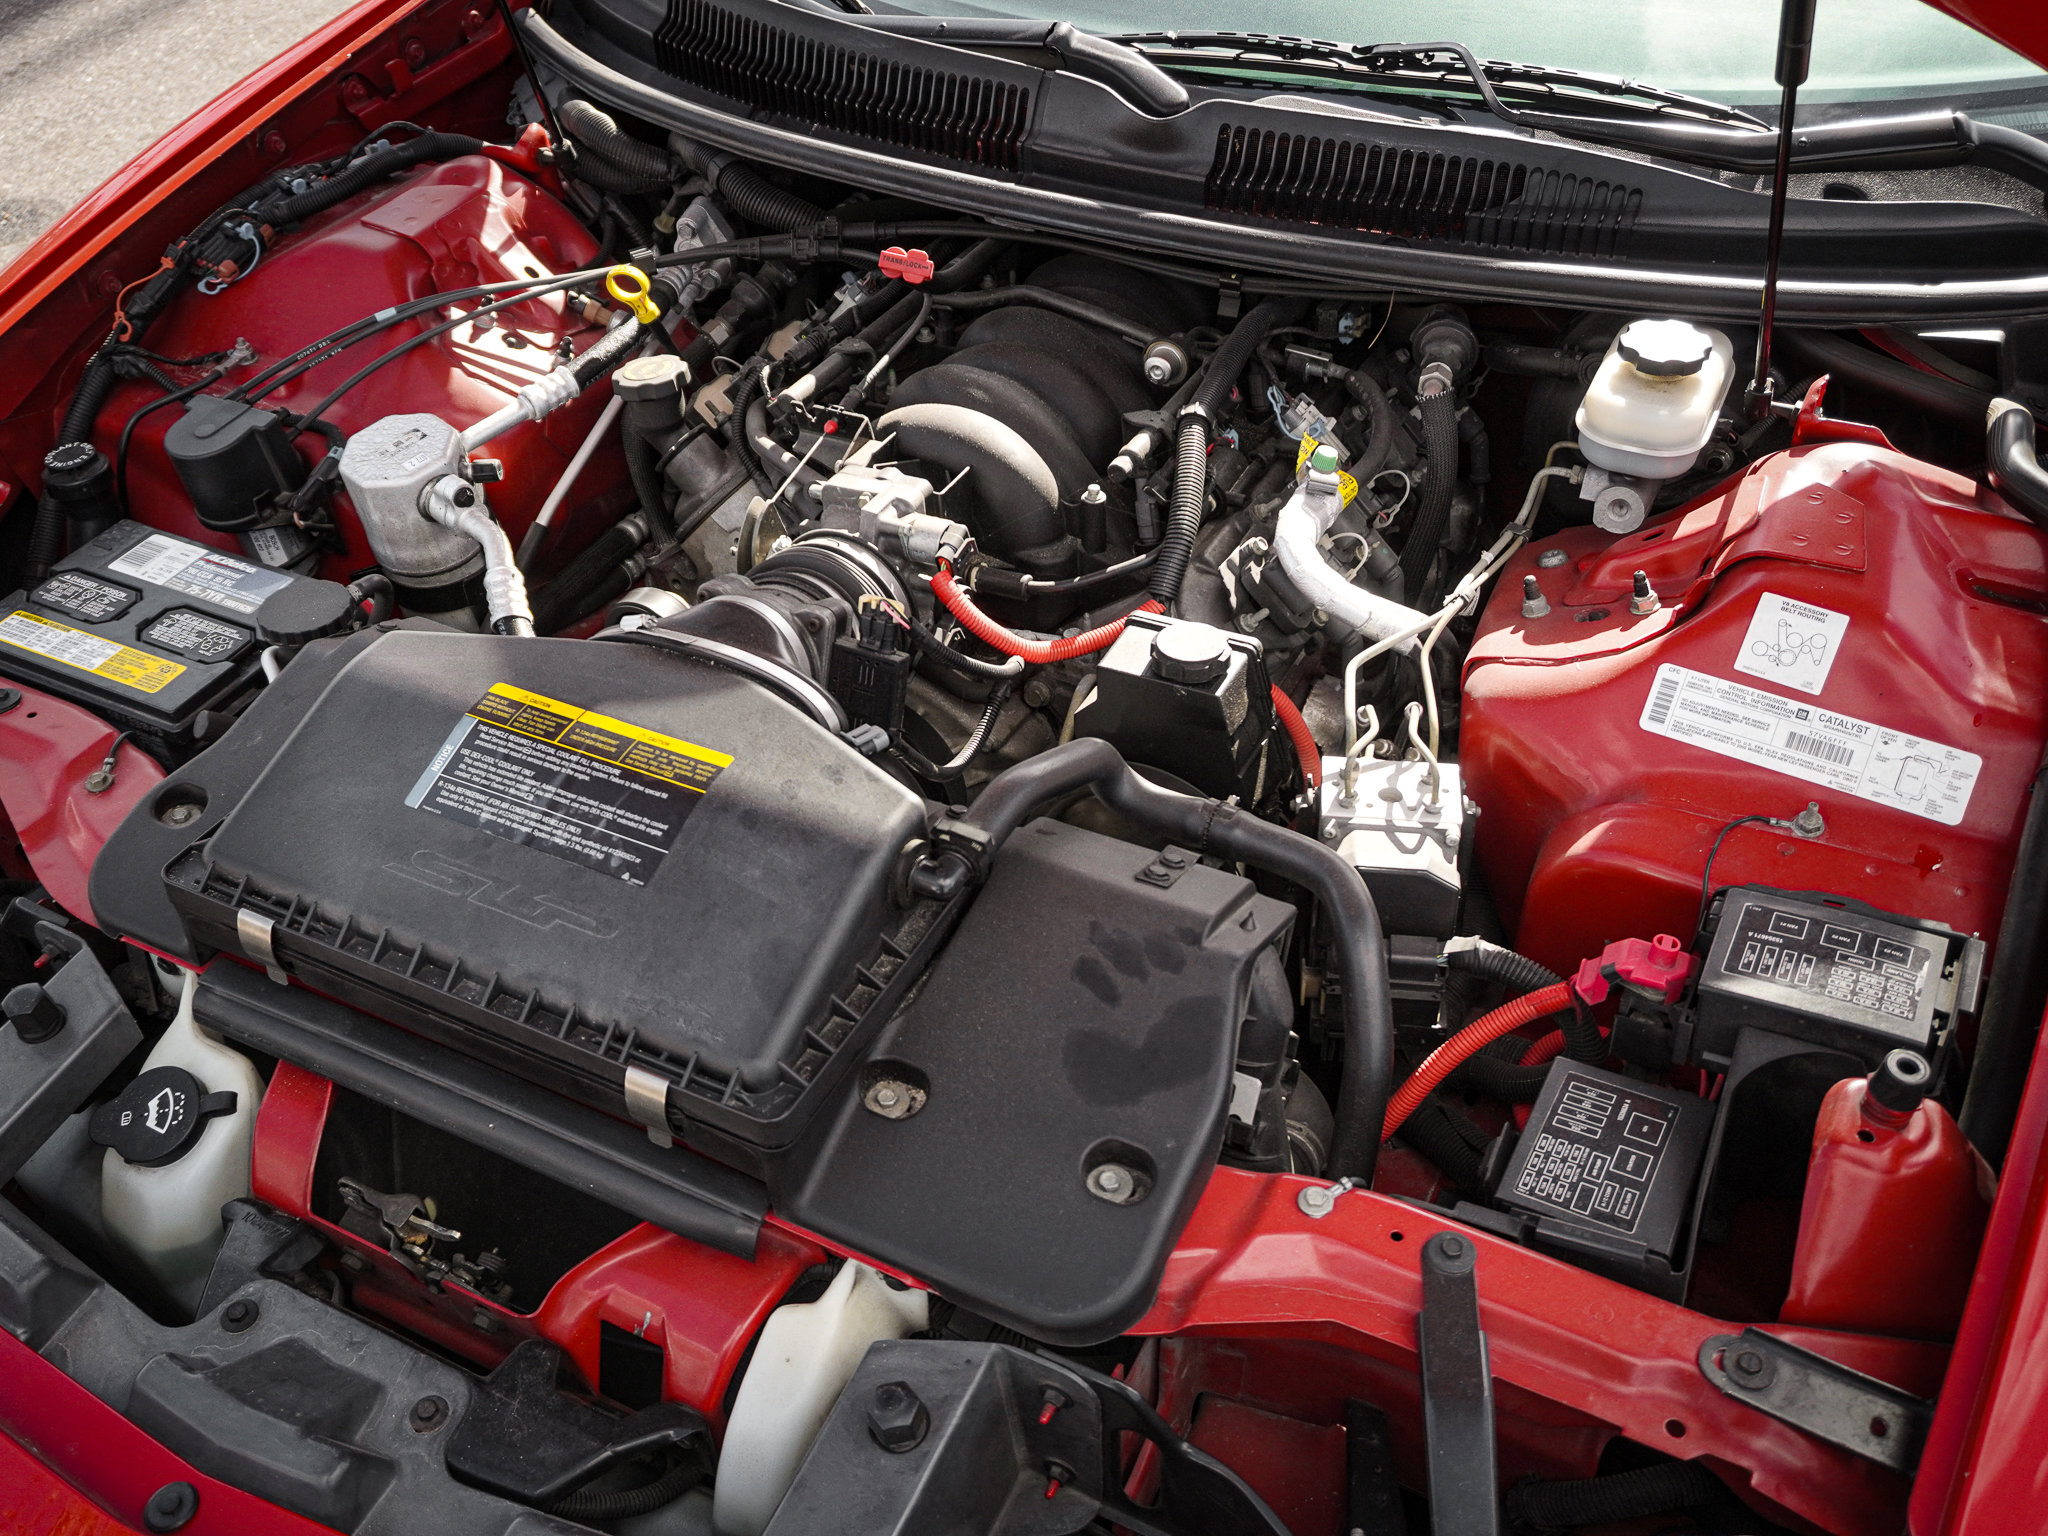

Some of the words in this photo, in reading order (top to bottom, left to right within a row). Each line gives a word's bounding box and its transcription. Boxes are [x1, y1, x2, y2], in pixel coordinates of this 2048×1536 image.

[192, 559, 244, 580] Professional
[203, 551, 260, 574] ACDelco
[69, 575, 99, 589] DANGER
[100, 585, 127, 599] POISON
[1779, 605, 1796, 614] BELT
[1796, 610, 1826, 623] ROUTING
[1790, 603, 1829, 618] ACCESSORY
[1667, 666, 1681, 675] CFC
[1715, 687, 1748, 701] CONTROL
[1749, 697, 1795, 715] INFORMATION
[1727, 684, 1756, 697] VEHICLE
[1755, 692, 1789, 707] EMISSION
[1817, 712, 1870, 736] CATALYST
[475, 723, 490, 732] THIS
[487, 727, 509, 738] VEHICLE
[534, 743, 558, 754] SPECIAL
[554, 749, 581, 762] COOLANT
[431, 744, 454, 772] NOTICE
[458, 747, 472, 756] USE
[496, 760, 522, 773] COOLANT
[519, 767, 536, 777] ONLY
